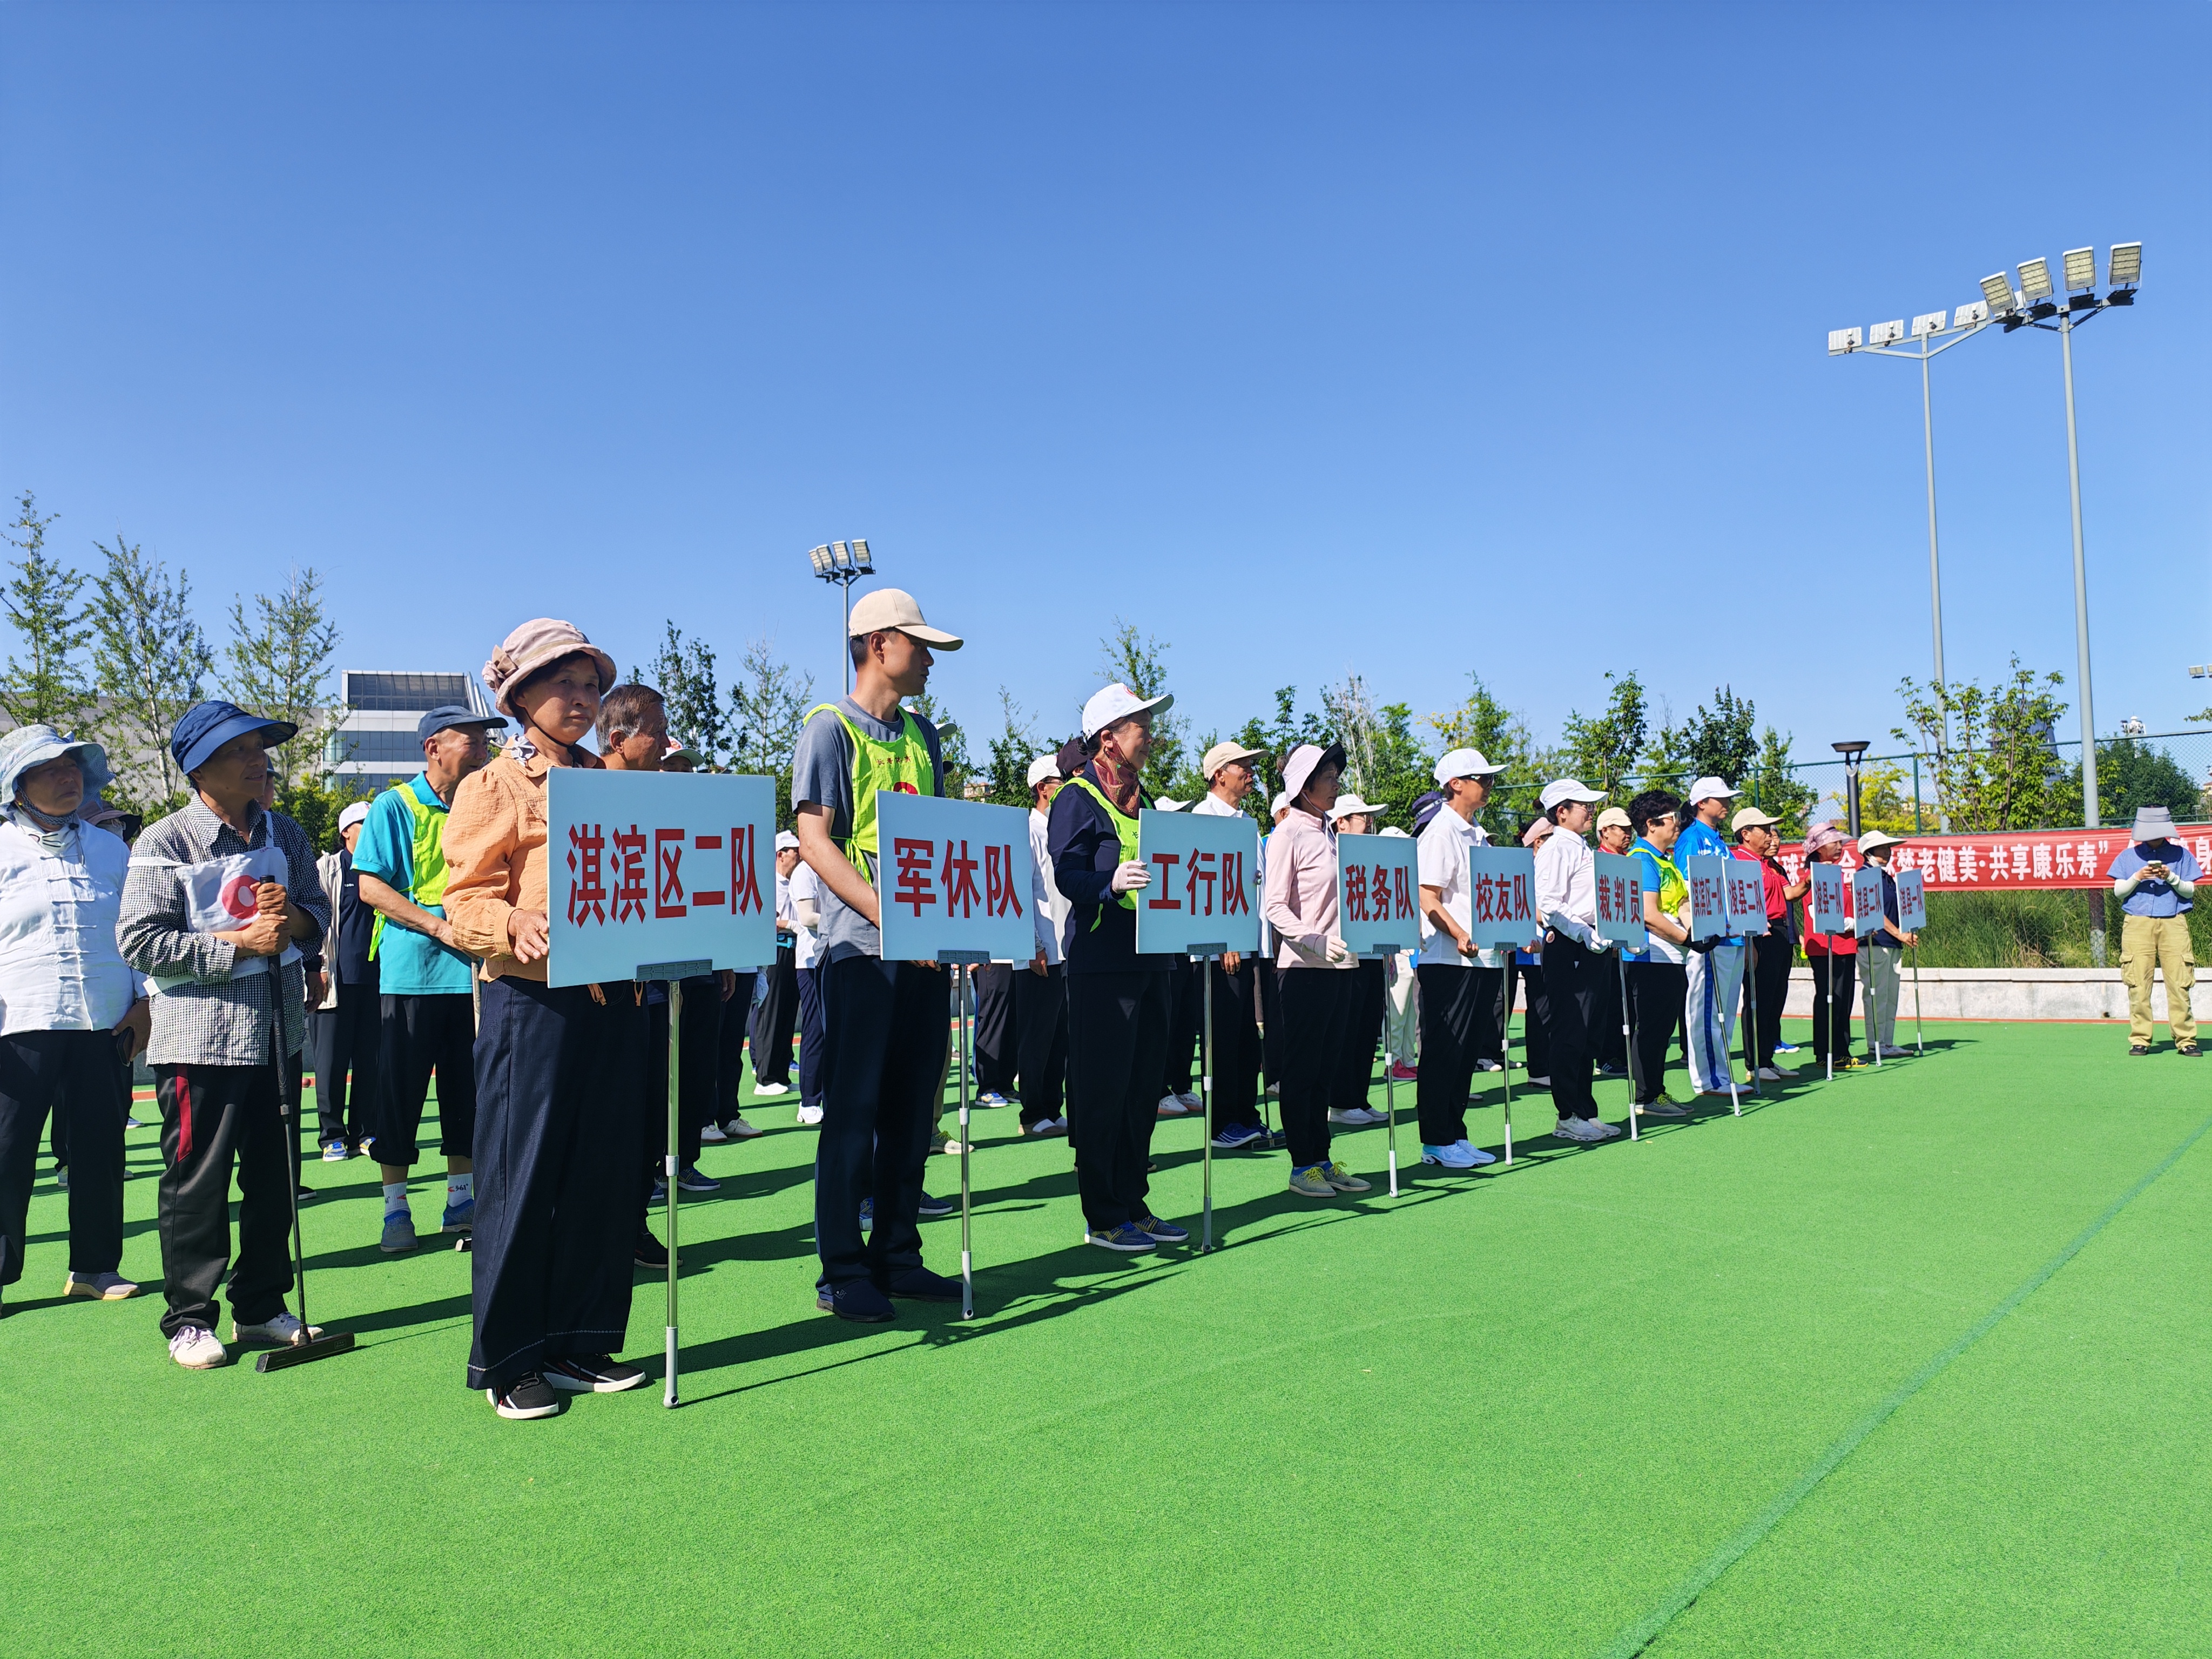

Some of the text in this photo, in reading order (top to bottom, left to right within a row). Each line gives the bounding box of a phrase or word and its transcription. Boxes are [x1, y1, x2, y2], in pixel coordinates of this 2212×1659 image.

[567, 824, 763, 928] 淇滨区二队
[894, 838, 1023, 919] 军休队
[1149, 848, 1249, 916] 工行队
[1345, 864, 1414, 922] 税务队
[1475, 873, 1532, 922] 校友队
[1599, 875, 1641, 923] 裁判员
[1692, 876, 1723, 918] 淇滨区一队
[1729, 879, 1764, 916] 浚县二队
